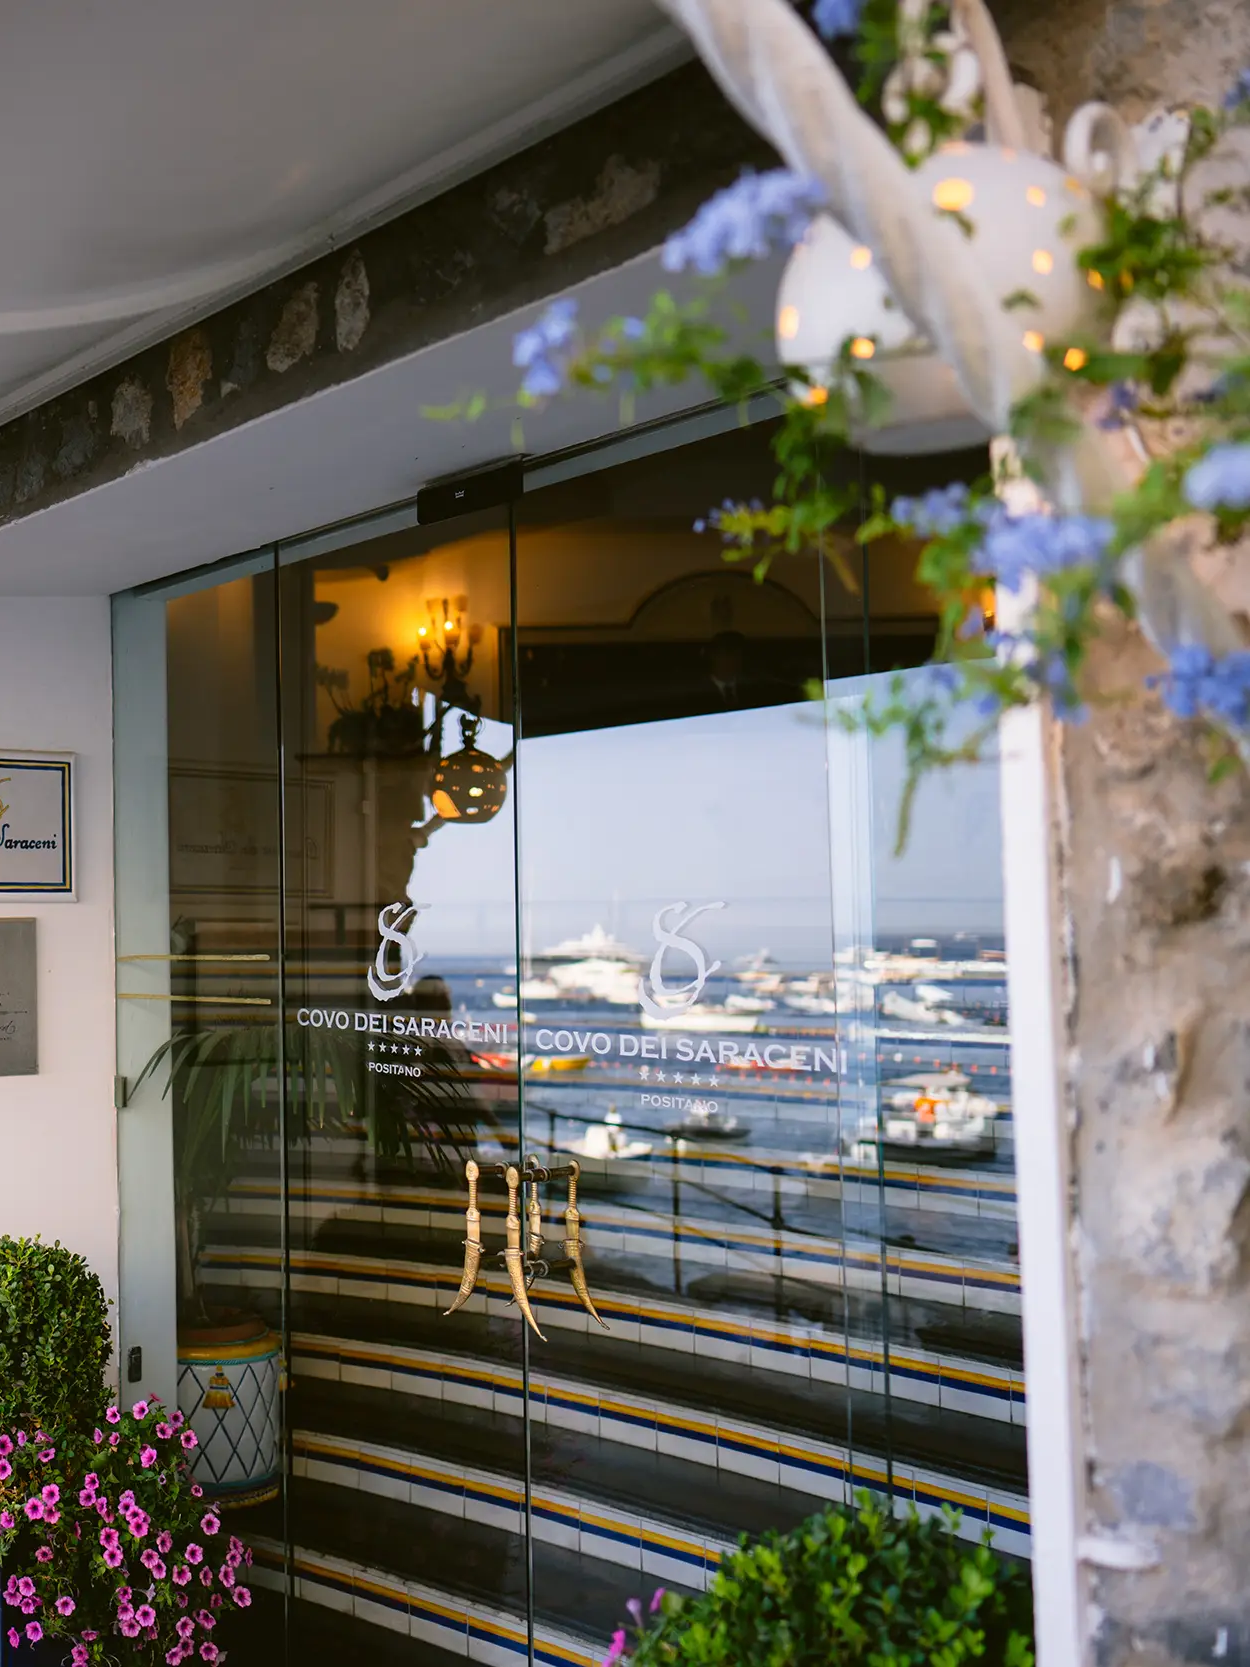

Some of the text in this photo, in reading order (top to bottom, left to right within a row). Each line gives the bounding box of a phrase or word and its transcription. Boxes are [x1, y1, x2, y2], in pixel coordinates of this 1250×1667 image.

[296, 1008, 508, 1044] COVO DEI SARACENI
[535, 1028, 848, 1075] COVO DEI SARACENI
[368, 1061, 422, 1078] POSITANO
[640, 1093, 719, 1114] POSITANO
